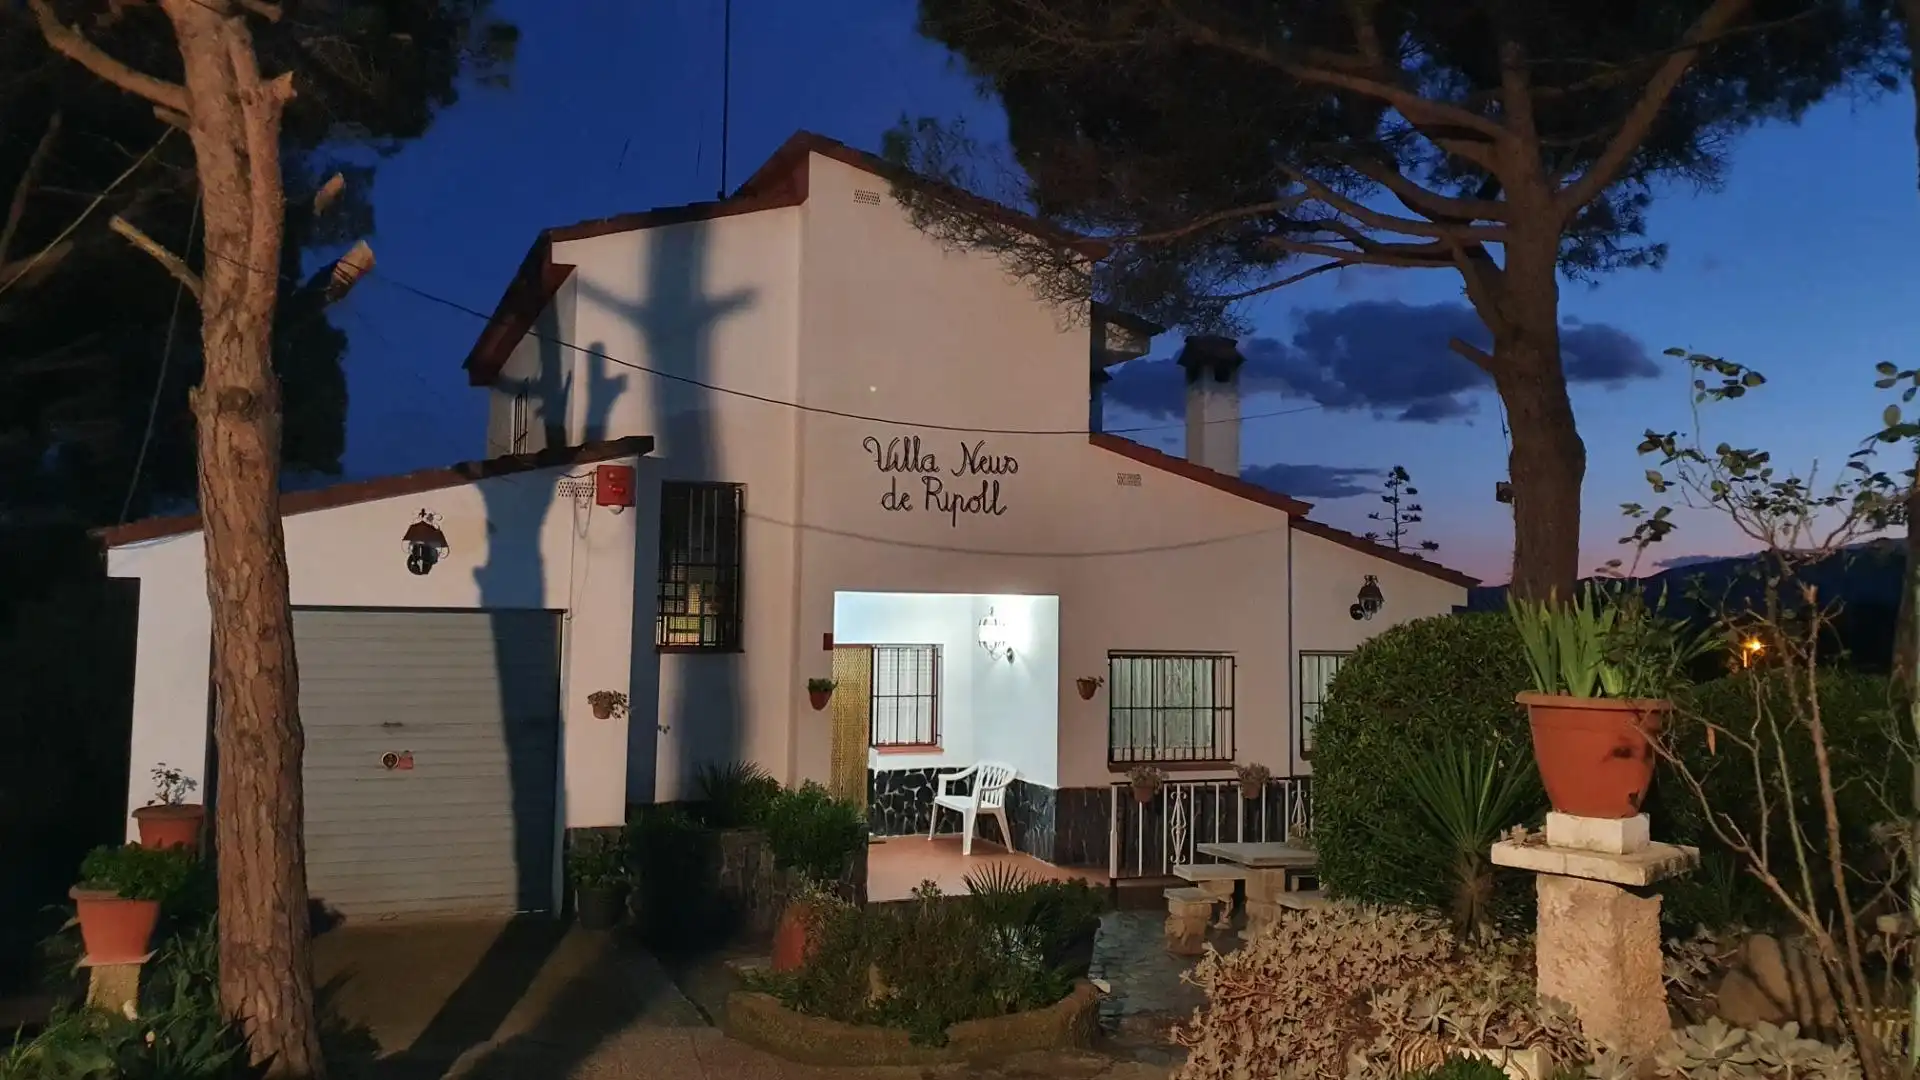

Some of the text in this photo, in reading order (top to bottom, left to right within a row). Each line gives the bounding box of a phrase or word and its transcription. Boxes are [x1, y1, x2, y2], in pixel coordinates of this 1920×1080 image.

[863, 435, 1019, 477] Villa Neus
[881, 475, 1008, 527] de Ripoll
